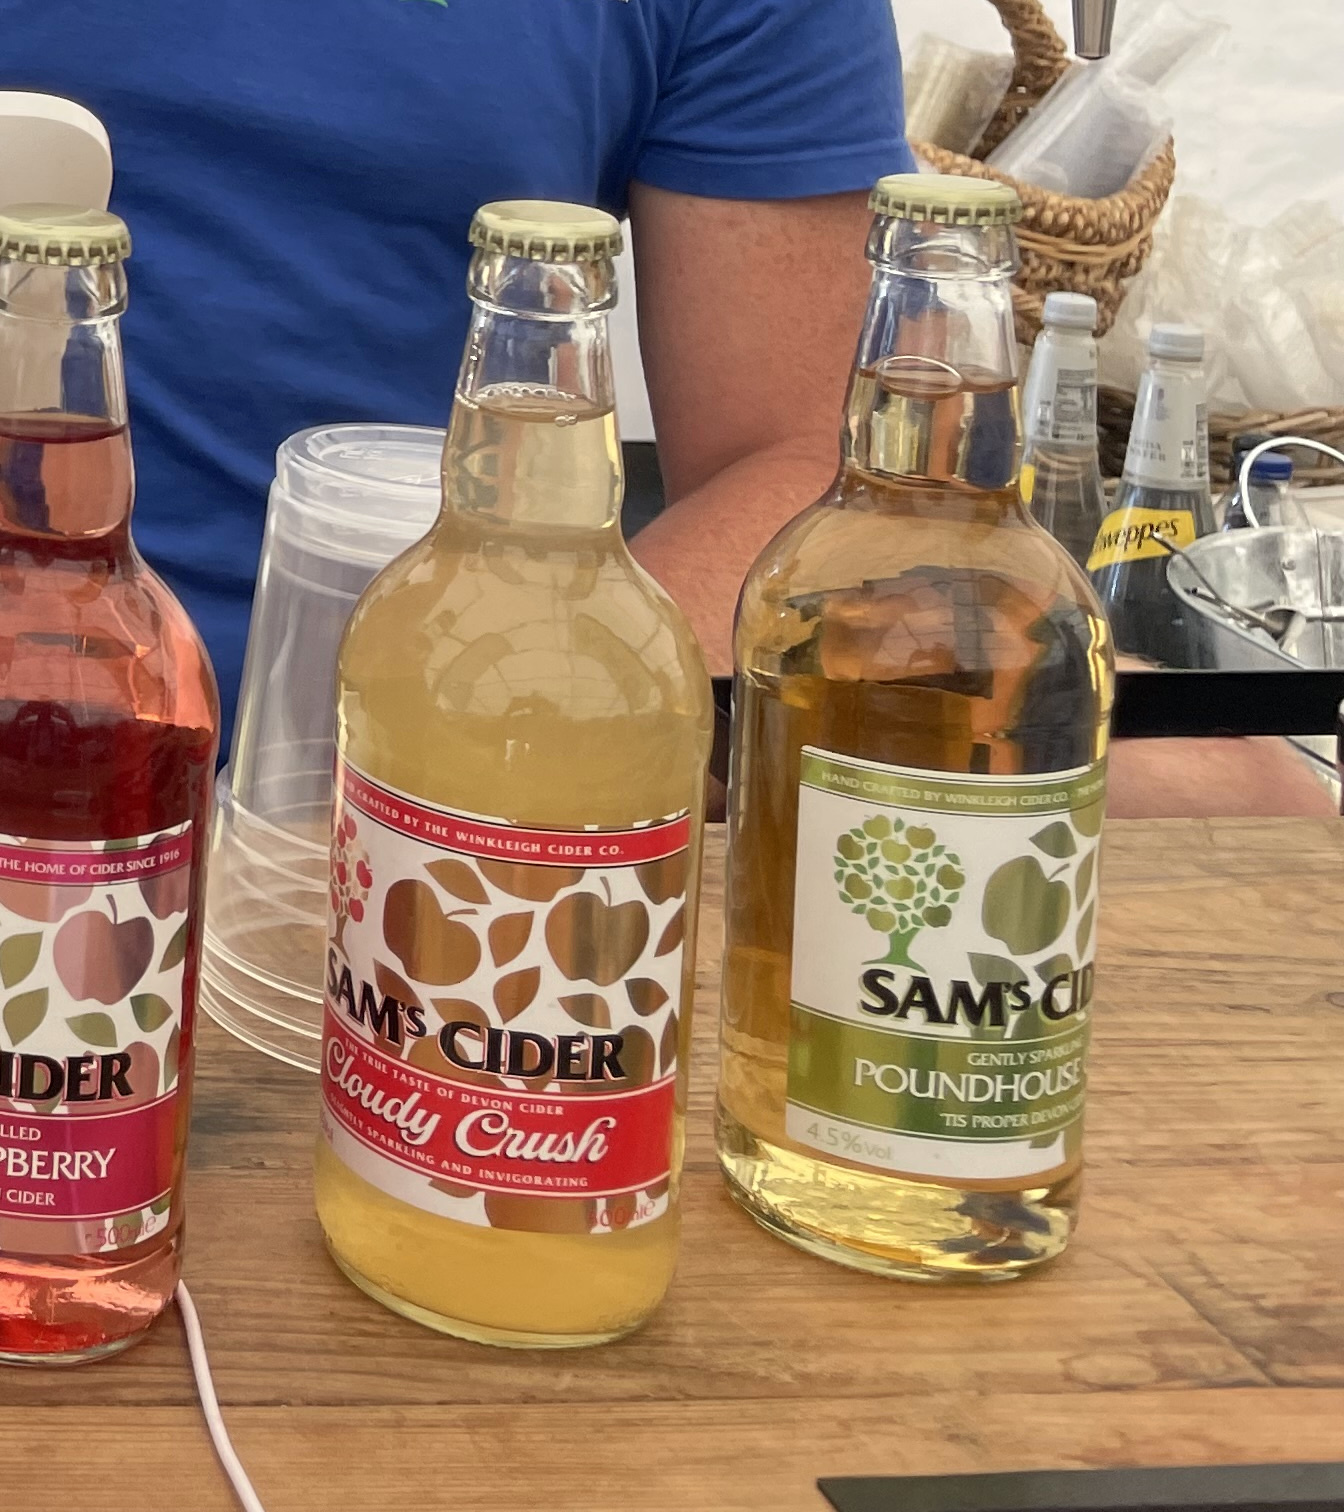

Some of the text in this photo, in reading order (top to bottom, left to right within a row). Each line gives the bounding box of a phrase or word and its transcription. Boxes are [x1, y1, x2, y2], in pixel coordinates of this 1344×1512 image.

[822, 771, 860, 788] HAND
[924, 791, 941, 801] BY
[945, 793, 1017, 806] WINKLEIGH
[1020, 794, 1051, 806] CIDER
[357, 788, 399, 819] CRAFTED
[404, 814, 419, 827] BY
[425, 821, 448, 837] THE
[456, 830, 541, 854] WINKLEIGH
[547, 843, 593, 856] CIDER
[24, 862, 65, 875] HOME
[69, 864, 87, 875] OF
[90, 863, 124, 875] CIDER
[126, 856, 156, 870] SINCE
[160, 849, 179, 865] 1916
[438, 1020, 626, 1081] CIDER
[968, 1052, 1028, 1066] GENTLY
[327, 1037, 441, 1145] Cloudy
[455, 1108, 617, 1163] Crush
[362, 1052, 388, 1074] TRUE
[393, 1069, 430, 1092] TASTE
[437, 1087, 454, 1099] OF
[461, 1093, 513, 1112] DEVON
[519, 1102, 564, 1115] CIDER
[854, 1056, 1081, 1103] POUNDHOUSE
[972, 1113, 1028, 1128] PROPER
[367, 1126, 589, 1187] SPARKLING AND INVIGORATING
[6, 1189, 56, 1206] CIDER
